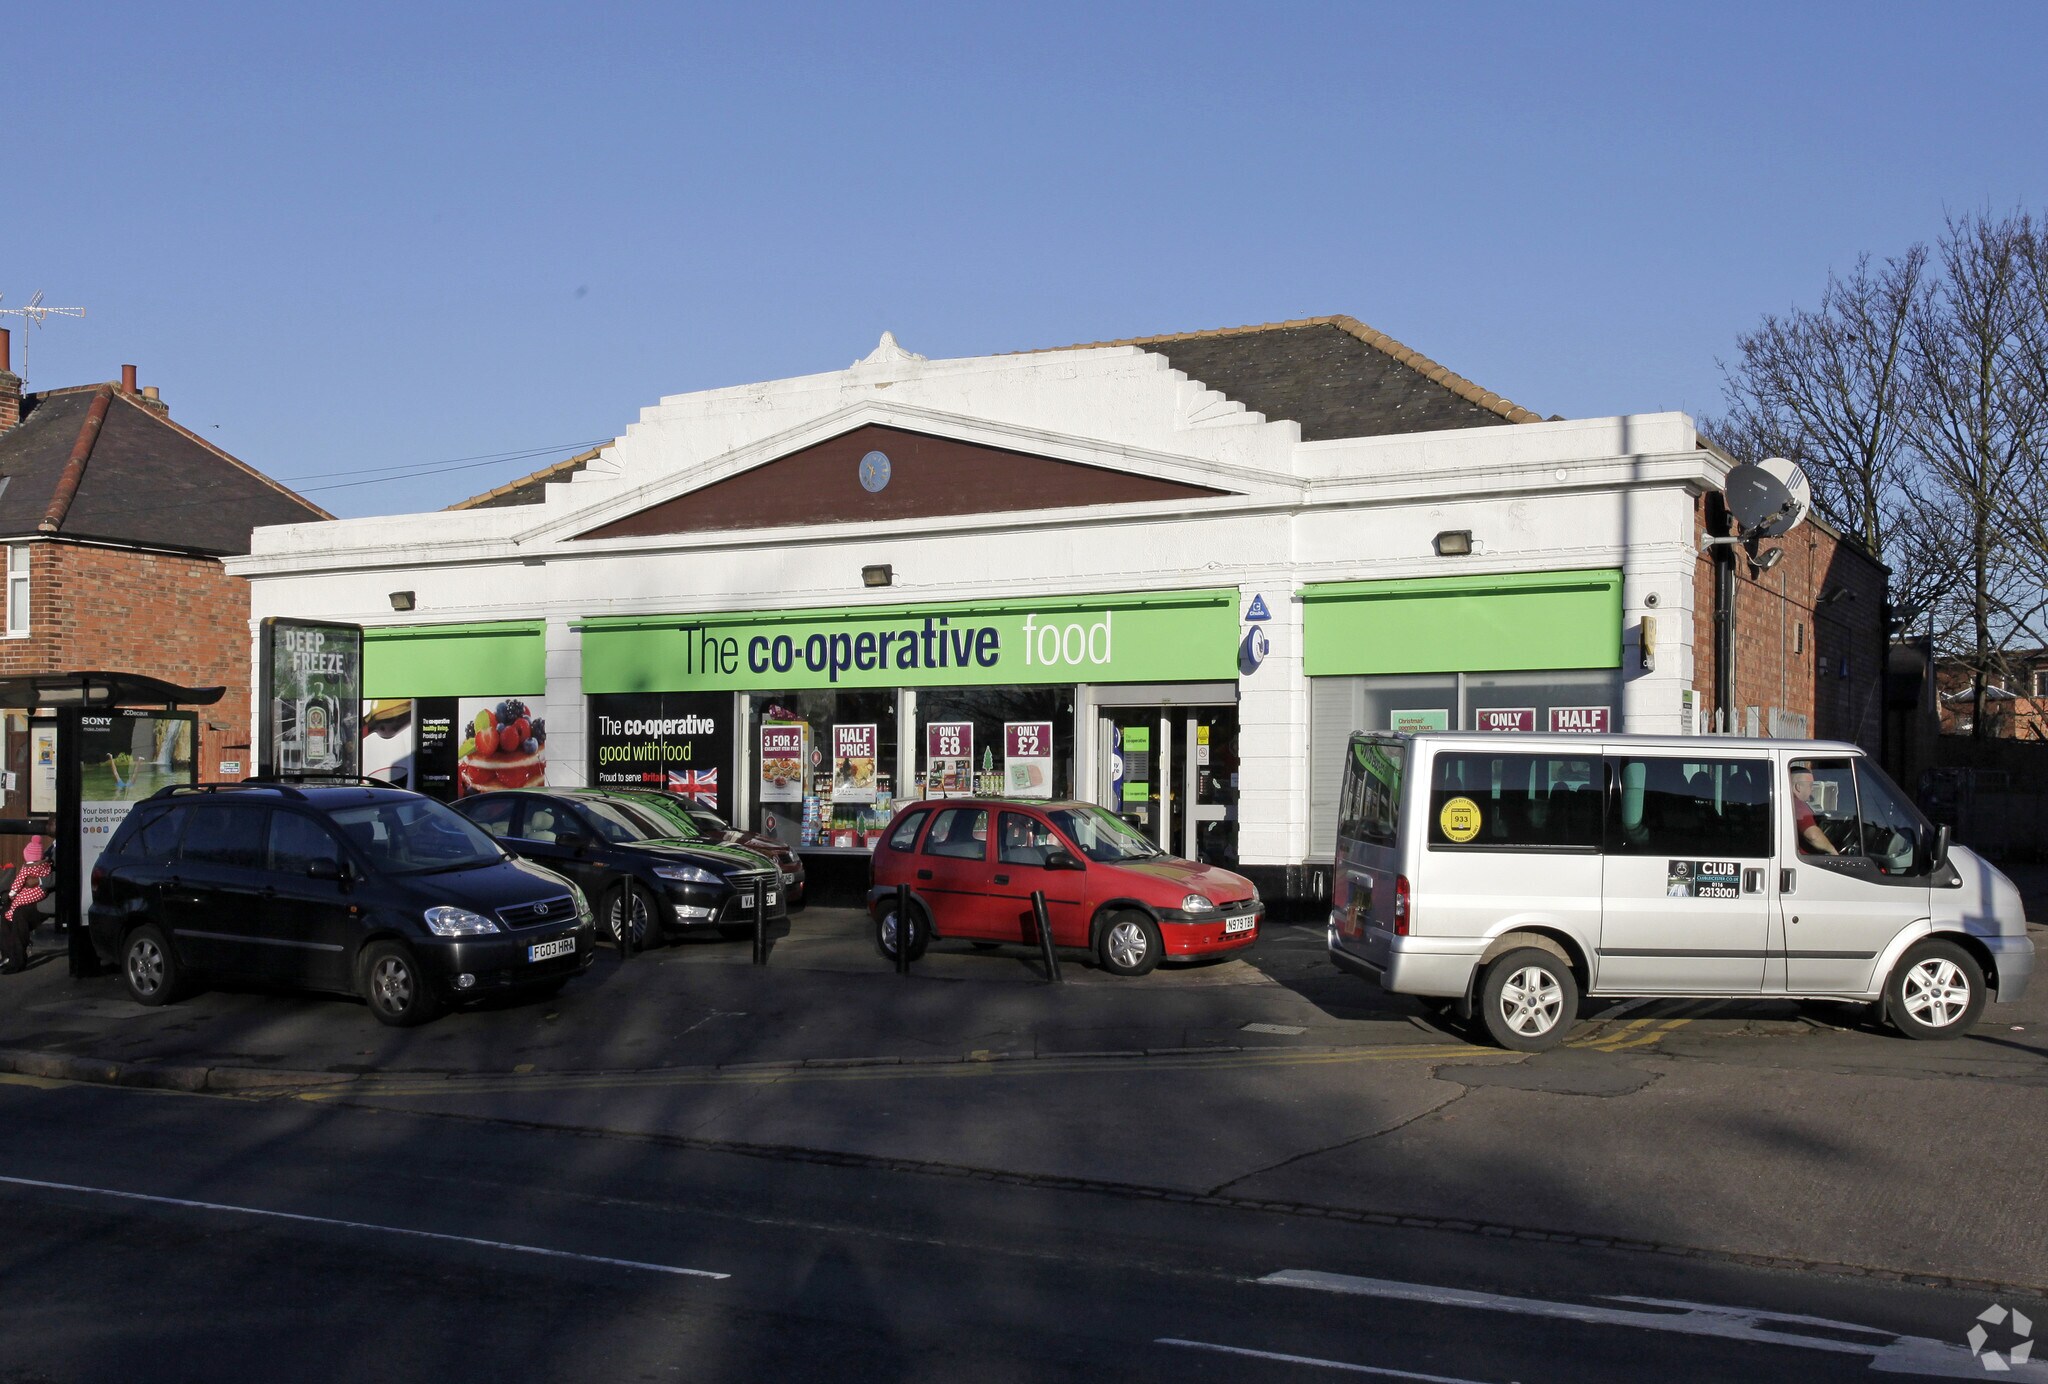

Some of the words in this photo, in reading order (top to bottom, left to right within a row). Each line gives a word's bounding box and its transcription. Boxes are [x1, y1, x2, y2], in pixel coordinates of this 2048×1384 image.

[286, 631, 325, 652] DEEP
[679, 627, 739, 674] The
[749, 616, 1000, 682] co-operative
[1022, 611, 1111, 666] food
[293, 652, 344, 674] FREEZE
[82, 717, 112, 725] SONY
[1489, 713, 1522, 726] ONLY
[1558, 710, 1602, 727] HALF
[599, 716, 622, 736] The
[624, 714, 715, 739] co-operative
[940, 727, 961, 737] ONLY
[1018, 726, 1039, 737] ONLY
[764, 736, 769, 747] 3
[773, 735, 790, 746] FOR
[793, 735, 799, 746] 2
[839, 728, 871, 743] HALF
[599, 742, 631, 766] good
[633, 742, 660, 761] with
[662, 741, 692, 761] food
[839, 744, 871, 756] PRICE
[940, 737, 961, 756] £8
[1018, 737, 1039, 756] £2
[599, 773, 617, 782] Proud
[618, 773, 624, 782] to
[625, 774, 642, 782] serve
[642, 773, 667, 782] Britain
[1702, 862, 1735, 875] CLUB
[1228, 918, 1244, 931] N979
[534, 943, 557, 959] FG03
[558, 939, 574, 953] HRA
